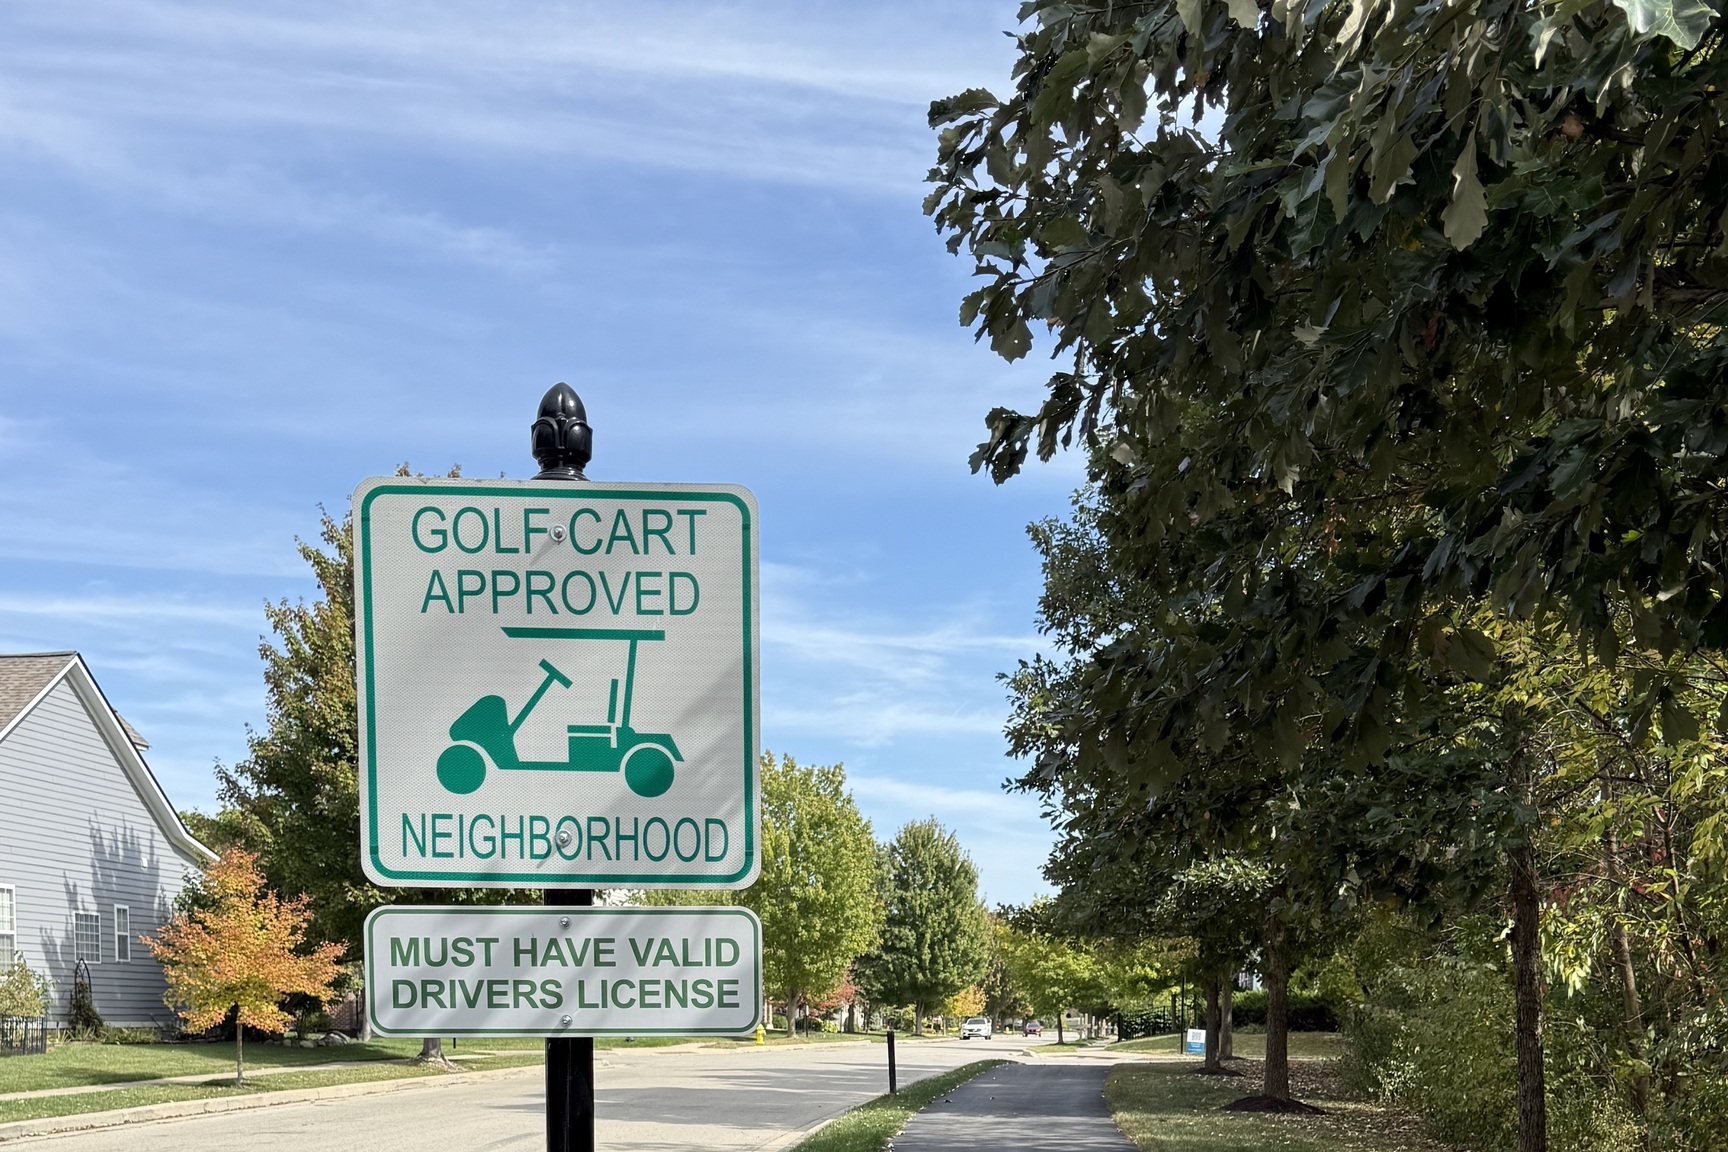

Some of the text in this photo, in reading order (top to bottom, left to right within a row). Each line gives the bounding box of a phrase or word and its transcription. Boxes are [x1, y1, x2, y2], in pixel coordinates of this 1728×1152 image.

[411, 506, 707, 555] GOLF CART
[420, 569, 700, 616] APPROVED
[401, 812, 729, 862] NEIGHBORHOOD
[390, 937, 740, 967] MUST HAVE VALID
[392, 979, 740, 1010] DRIVERS LICENSE
